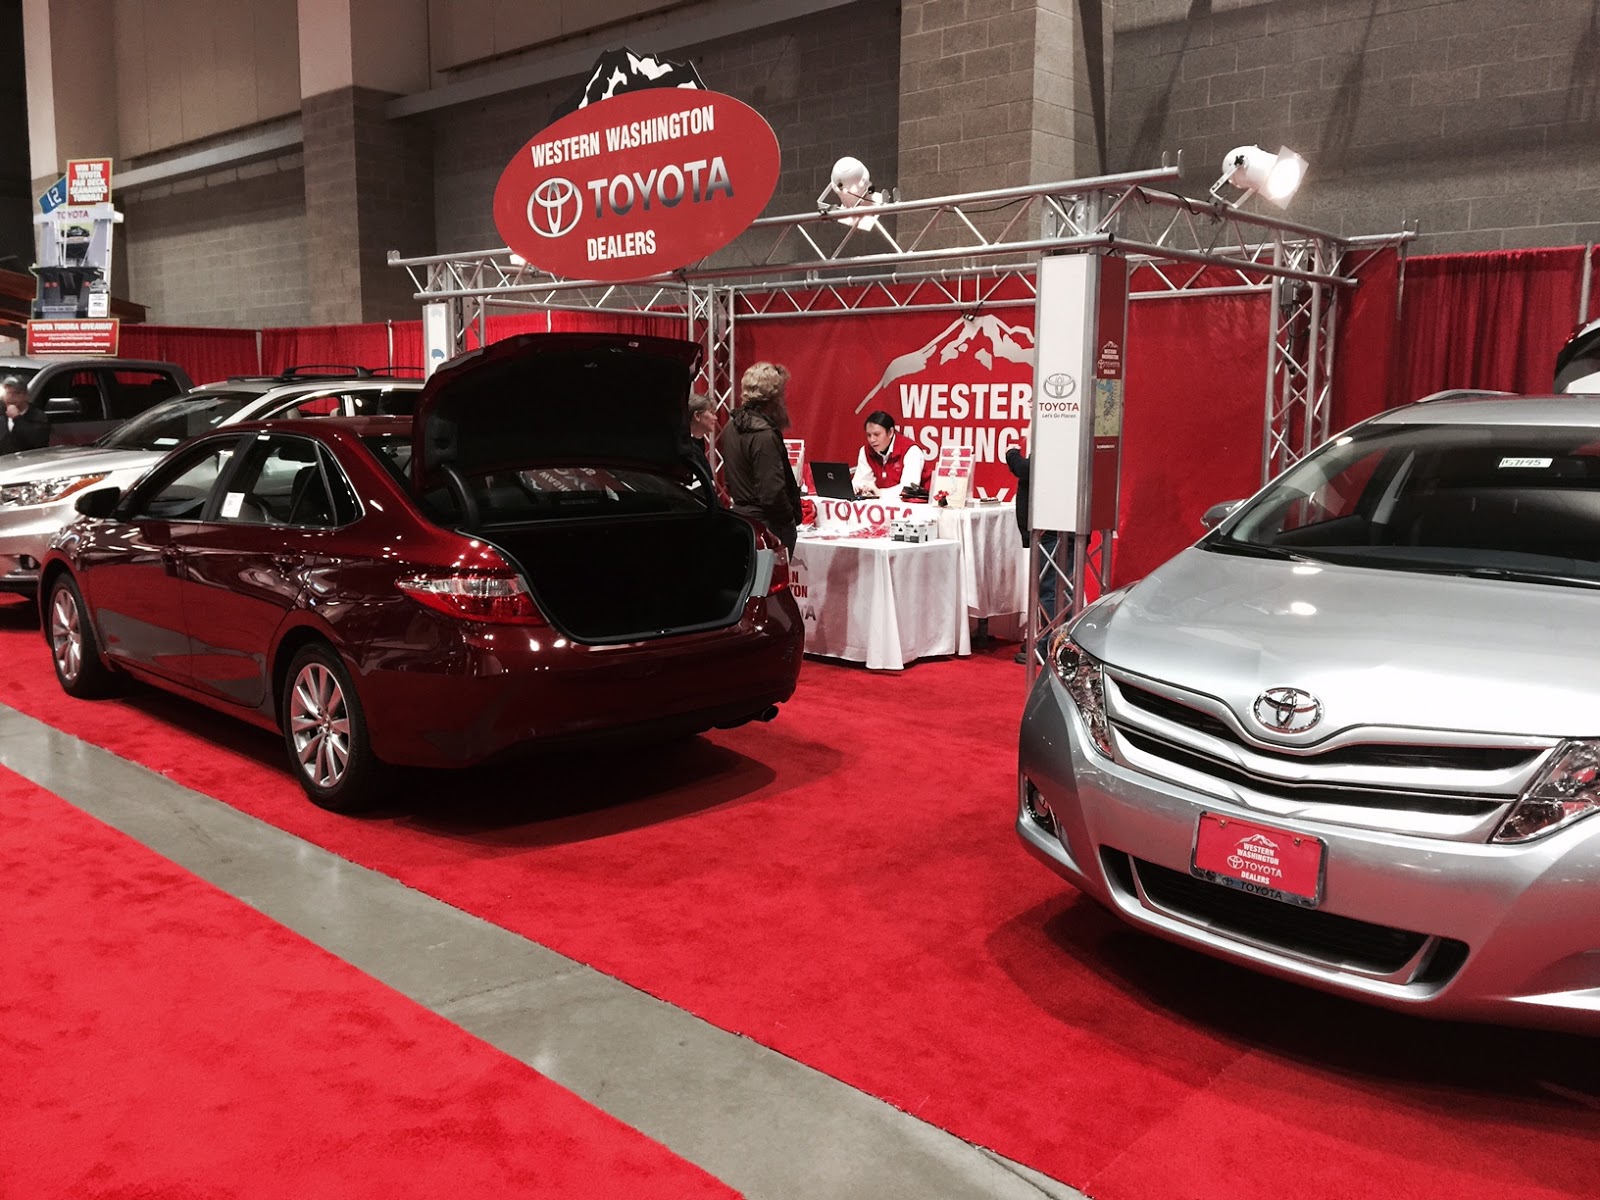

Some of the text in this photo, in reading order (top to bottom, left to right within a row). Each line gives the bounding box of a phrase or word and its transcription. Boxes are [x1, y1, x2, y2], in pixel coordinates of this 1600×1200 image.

[531, 105, 715, 168] WESTERN WASHINGTON
[587, 156, 734, 218] TOYOTA
[586, 230, 657, 262] DEALERS
[1039, 402, 1079, 412] TOYOTA
[1236, 848, 1280, 866] WASHINGTON
[1243, 842, 1275, 857] WESTERN
[1240, 871, 1271, 885] DEALERS
[1244, 861, 1283, 878] TOYOTA
[1240, 882, 1283, 900] TOYOTA
